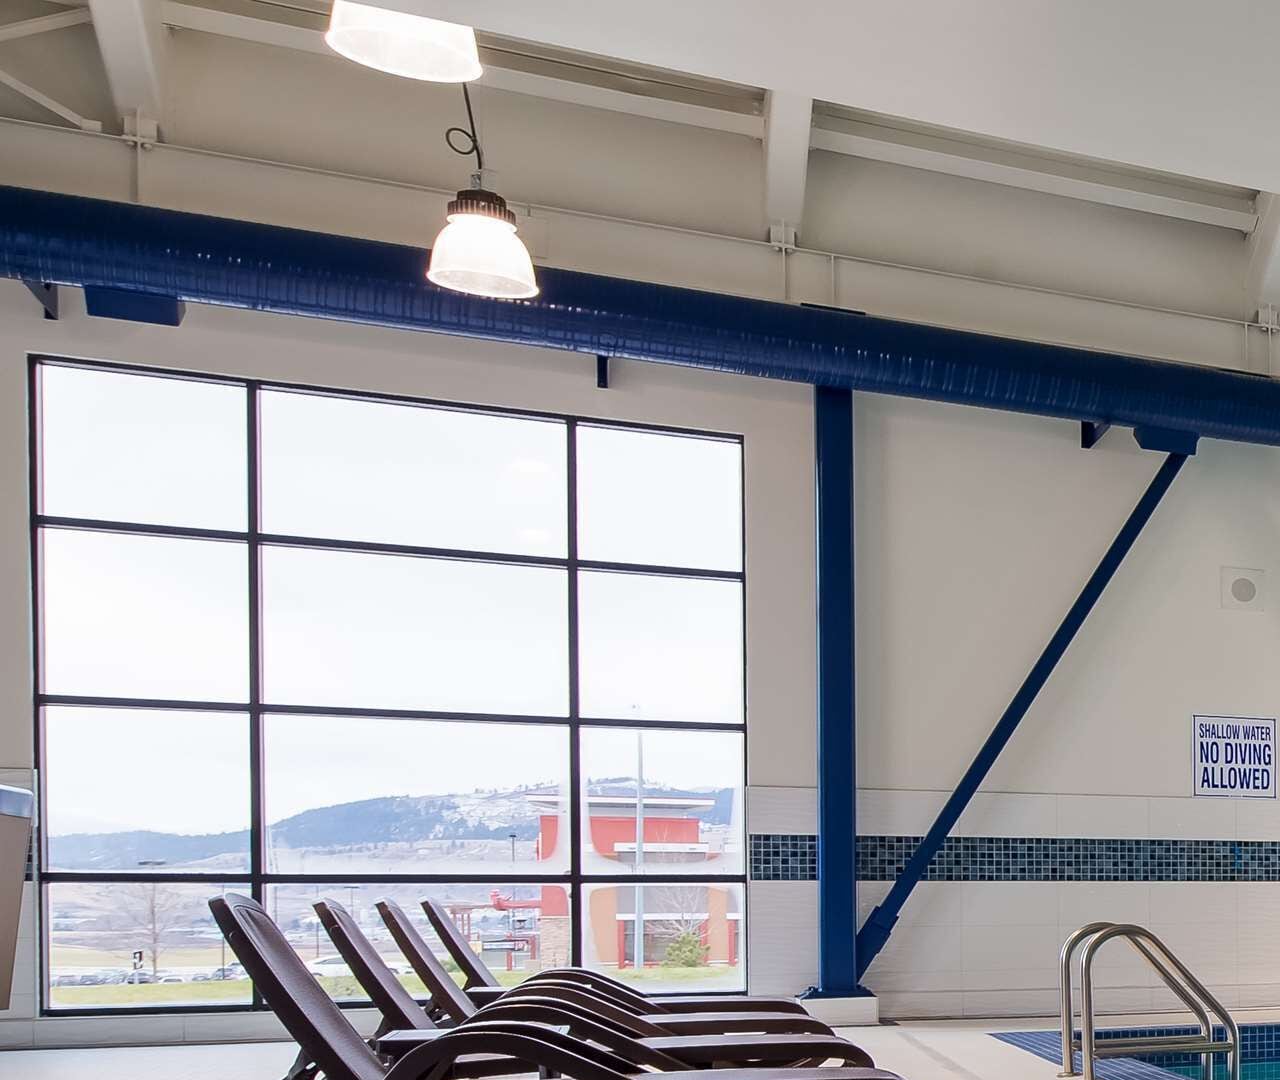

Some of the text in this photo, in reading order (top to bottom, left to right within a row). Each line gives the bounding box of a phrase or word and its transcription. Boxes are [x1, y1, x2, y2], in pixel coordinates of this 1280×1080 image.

[1199, 723, 1271, 741] SHALLOW WATER
[1200, 741, 1271, 766] NO DIVING
[1201, 767, 1270, 790] ALLOWED
